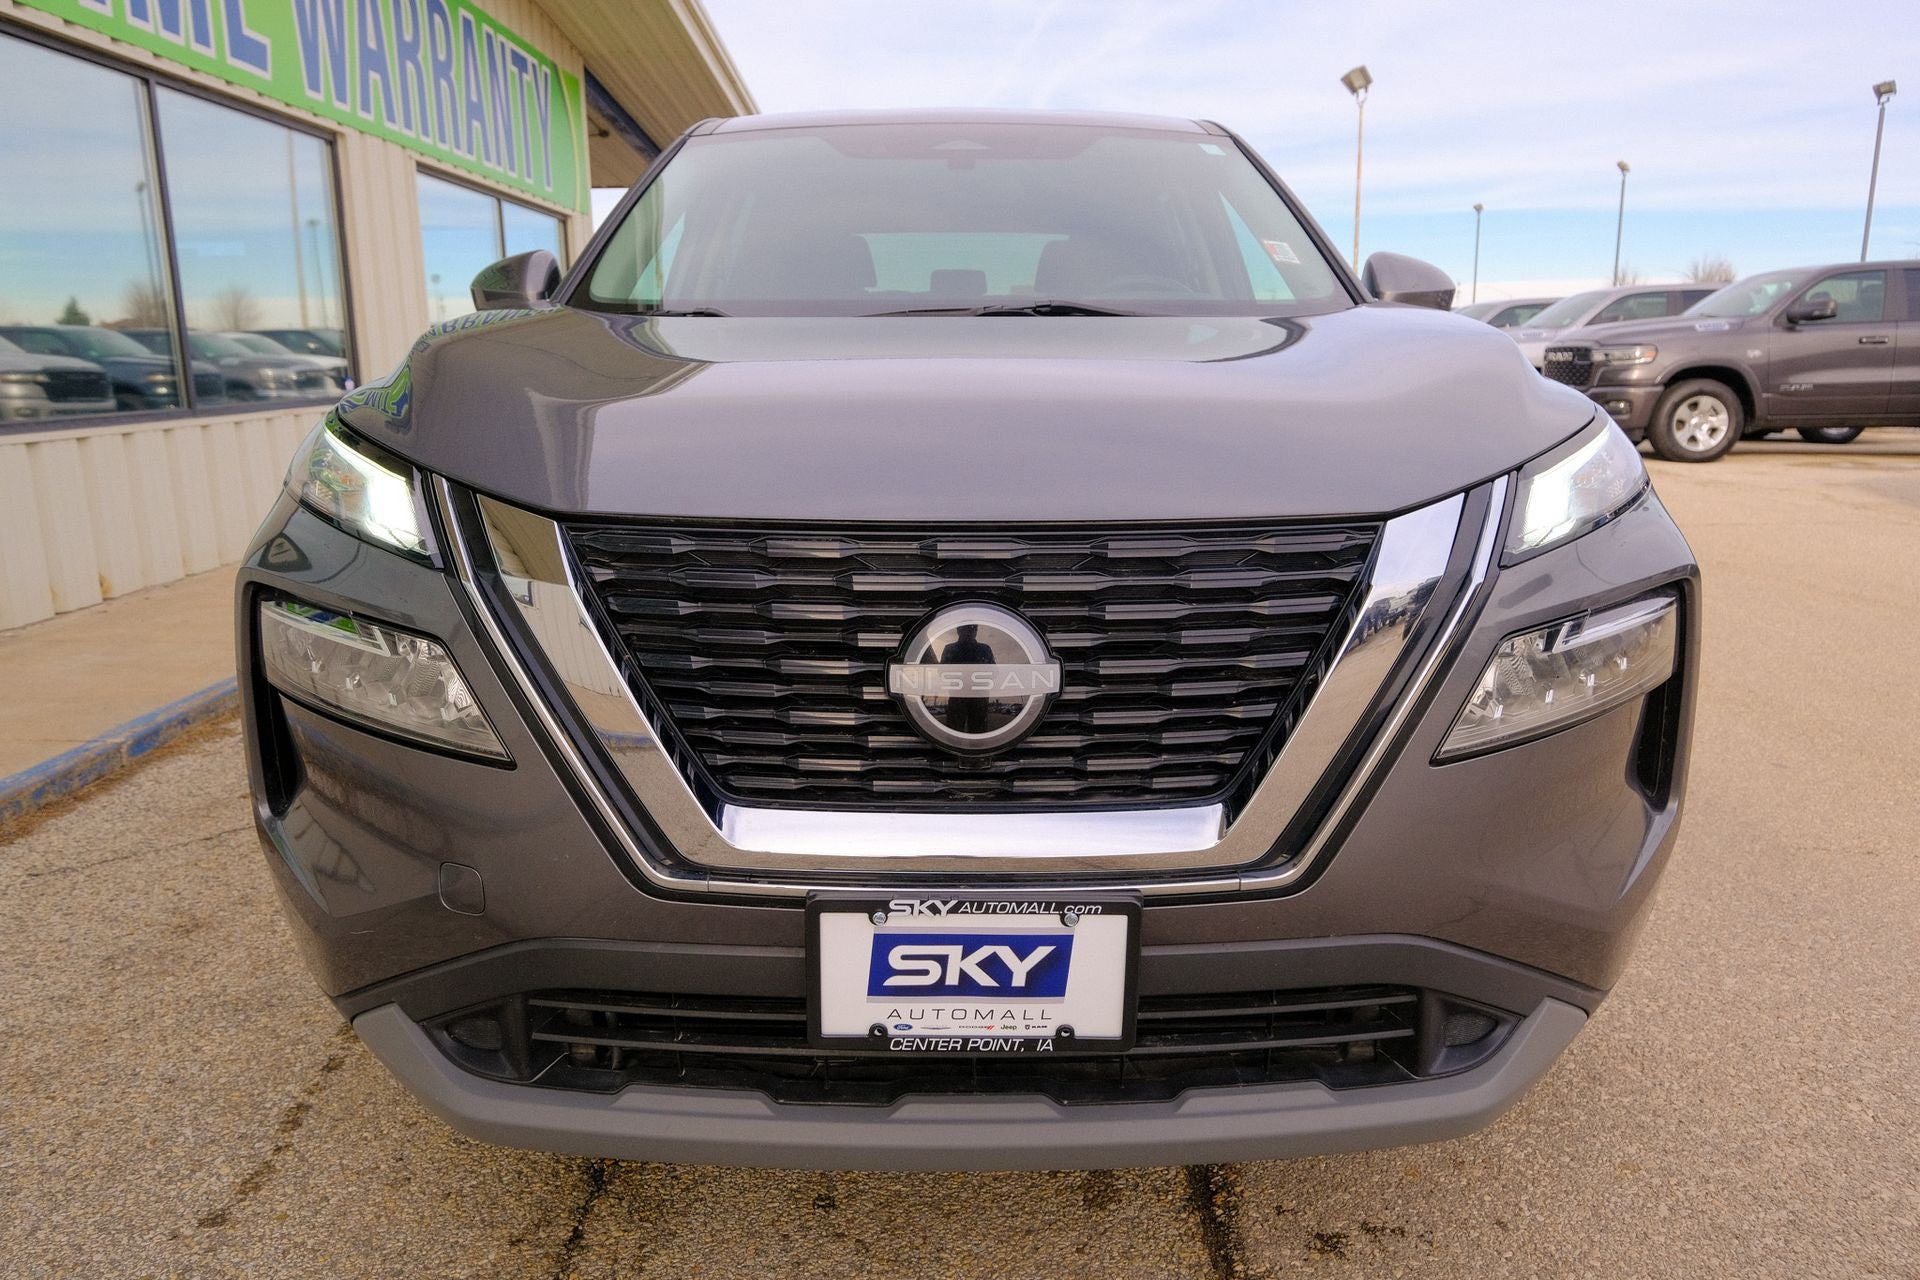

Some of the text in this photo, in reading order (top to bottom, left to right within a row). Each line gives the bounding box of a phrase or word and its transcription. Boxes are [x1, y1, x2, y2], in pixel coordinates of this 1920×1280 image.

[292, 0, 553, 192] WARRANTY
[895, 669, 1054, 691] NISSAN
[887, 899, 1102, 918] SKY AUTOMALL.com
[882, 944, 1057, 987] SKY
[887, 1008, 1052, 1020] AUTOMALL
[889, 1038, 1053, 1052] CENTER POINT, IA
